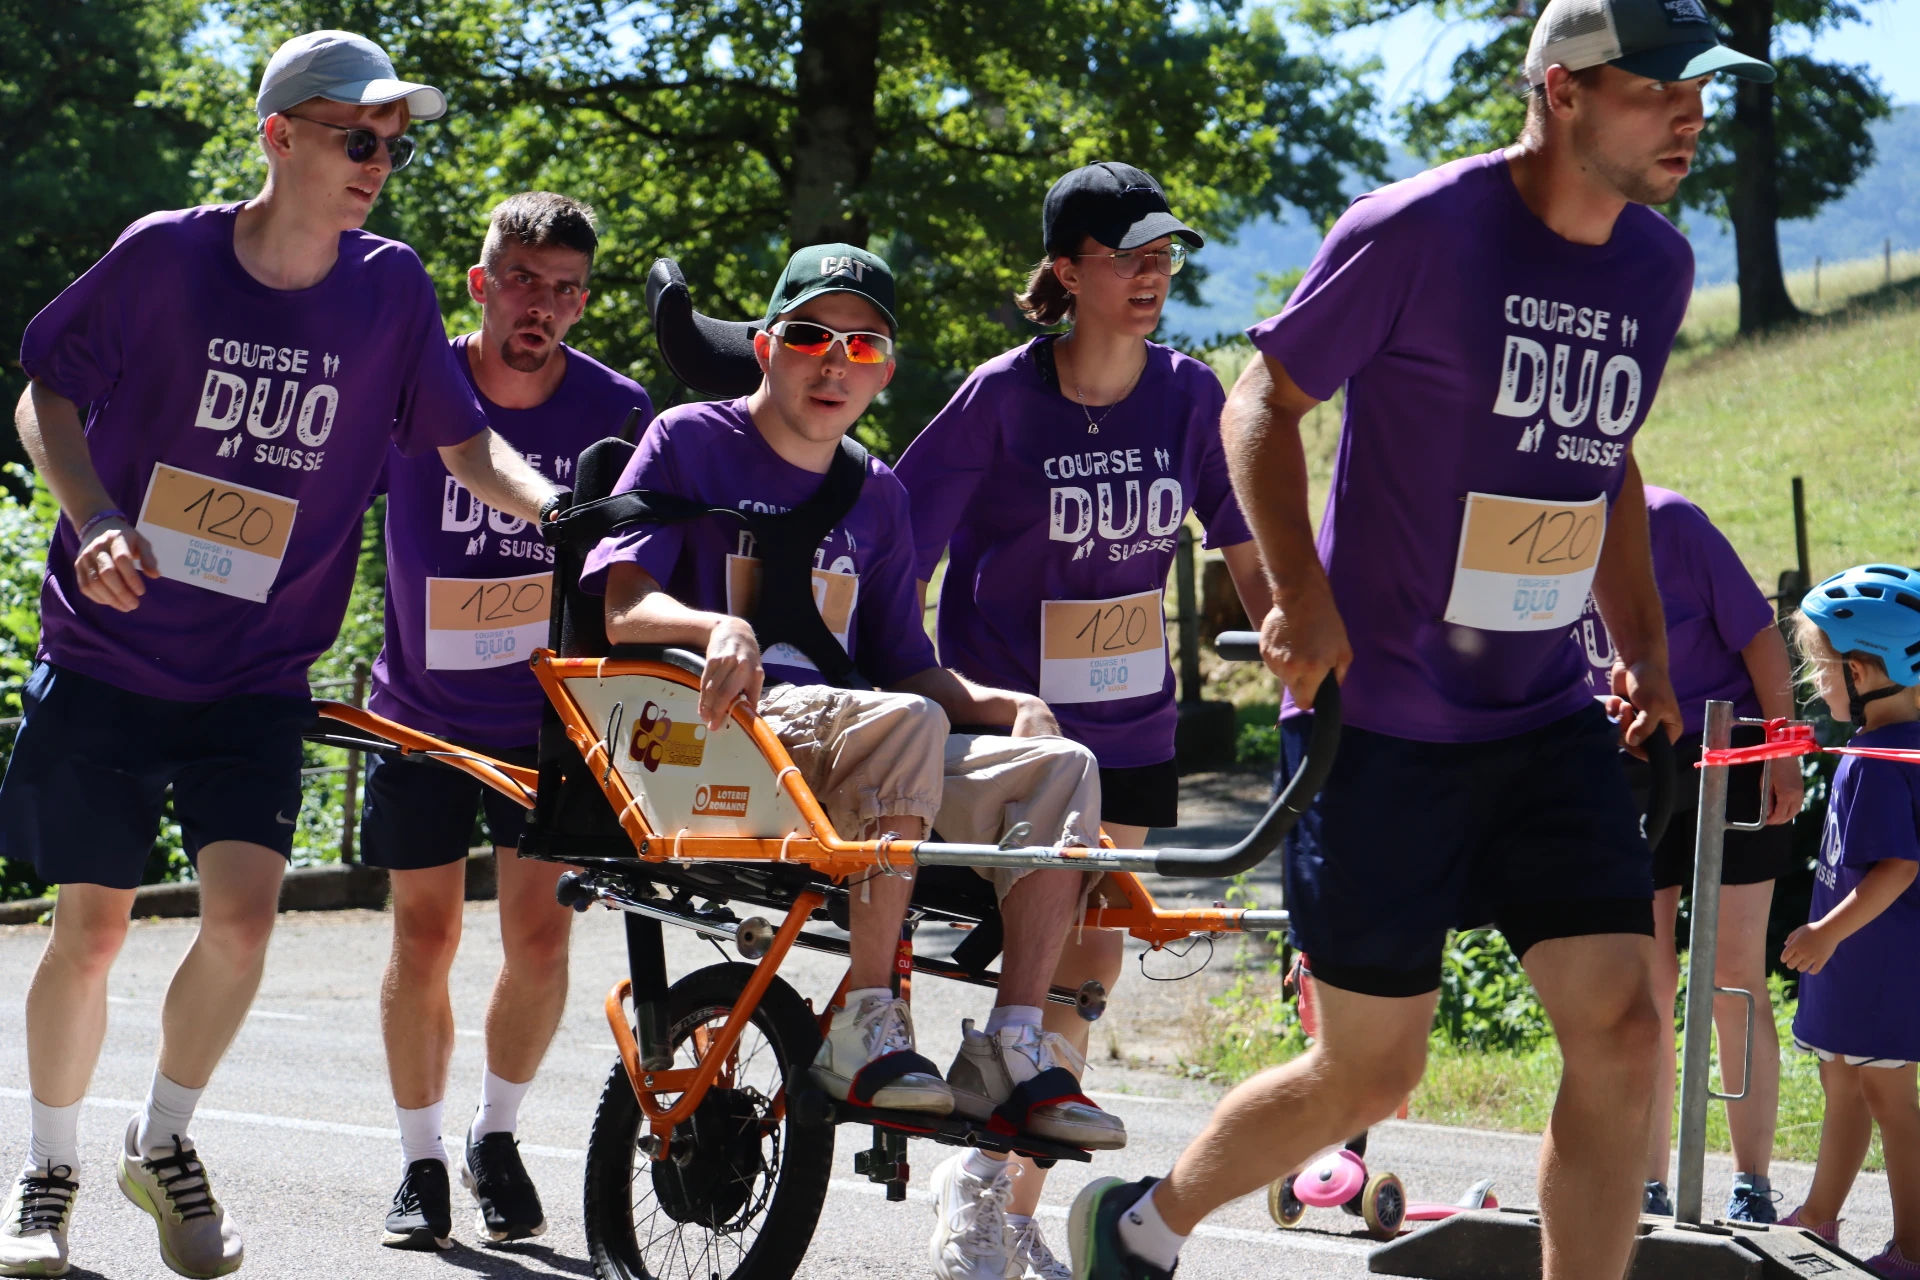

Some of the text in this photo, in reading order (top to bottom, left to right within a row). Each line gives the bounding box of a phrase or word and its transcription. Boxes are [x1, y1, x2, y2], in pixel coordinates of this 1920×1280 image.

[820, 256, 866, 283] CAT
[1504, 295, 1610, 341] COURSE
[207, 338, 309, 374] COURSE
[1492, 335, 1642, 436] DUO
[194, 368, 339, 447] DUO
[253, 443, 325, 471] SUISSE
[1043, 448, 1143, 479] COURSE
[1555, 434, 1625, 467] SUISSE
[183, 487, 274, 546] 120
[1049, 477, 1183, 543] DUO
[189, 539, 223, 554] COURSE
[1107, 537, 1176, 562] SUISSE
[1507, 510, 1597, 564] 120
[184, 548, 233, 577] DUO
[498, 538, 555, 564] SUISS
[202, 572, 229, 584] SUISSE
[460, 582, 545, 623] 120
[1512, 589, 1558, 612] DUO
[475, 630, 504, 639] COURSE
[1075, 604, 1147, 653] 120
[475, 636, 516, 656] DUO
[1090, 658, 1118, 668] COURSE
[1090, 665, 1128, 687] DUO
[1107, 684, 1128, 692] SUISSE
[708, 801, 747, 812] ROMANDE
[717, 790, 748, 800] LOTERIE
